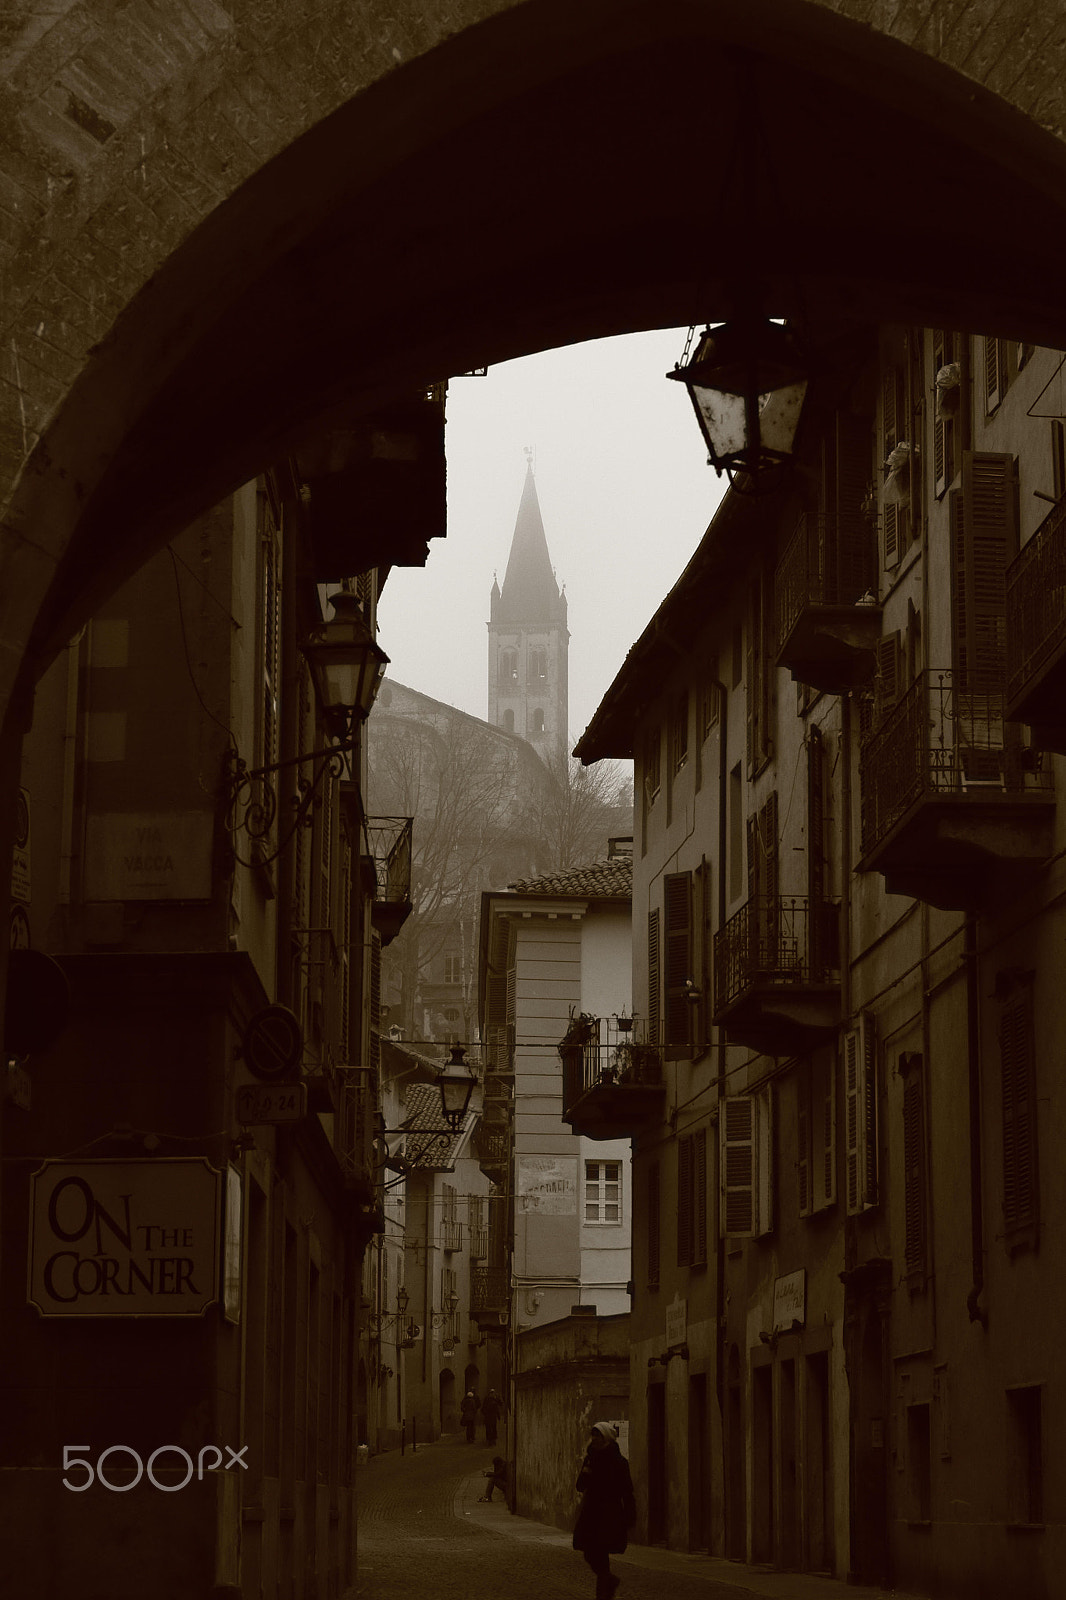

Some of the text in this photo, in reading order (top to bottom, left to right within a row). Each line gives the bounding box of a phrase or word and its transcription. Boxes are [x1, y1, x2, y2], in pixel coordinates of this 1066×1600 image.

[135, 827, 162, 843] VIA
[123, 855, 174, 872] VACCA
[47, 1175, 194, 1257] ON THE
[43, 1250, 202, 1303] CORNER
